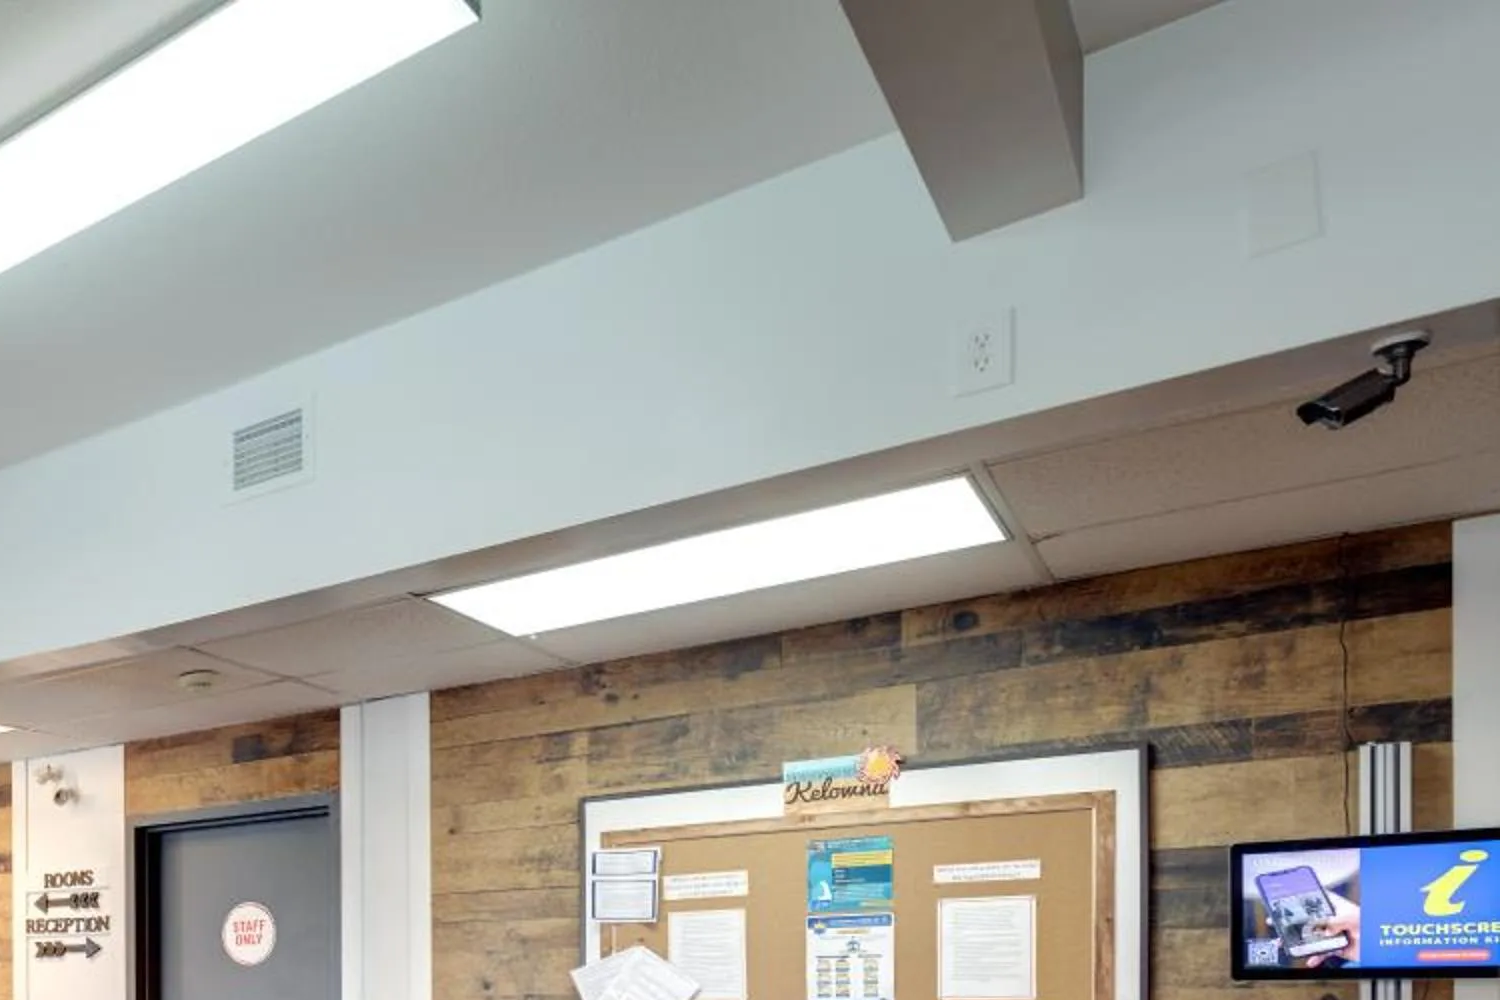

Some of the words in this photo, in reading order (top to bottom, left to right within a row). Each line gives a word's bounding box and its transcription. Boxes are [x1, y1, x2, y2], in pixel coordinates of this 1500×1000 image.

[784, 776, 889, 804] Kelowna
[44, 869, 94, 889] ROOMS
[25, 914, 110, 934] RECEPTION
[233, 919, 265, 933] STAFF
[235, 933, 262, 946] ONLY
